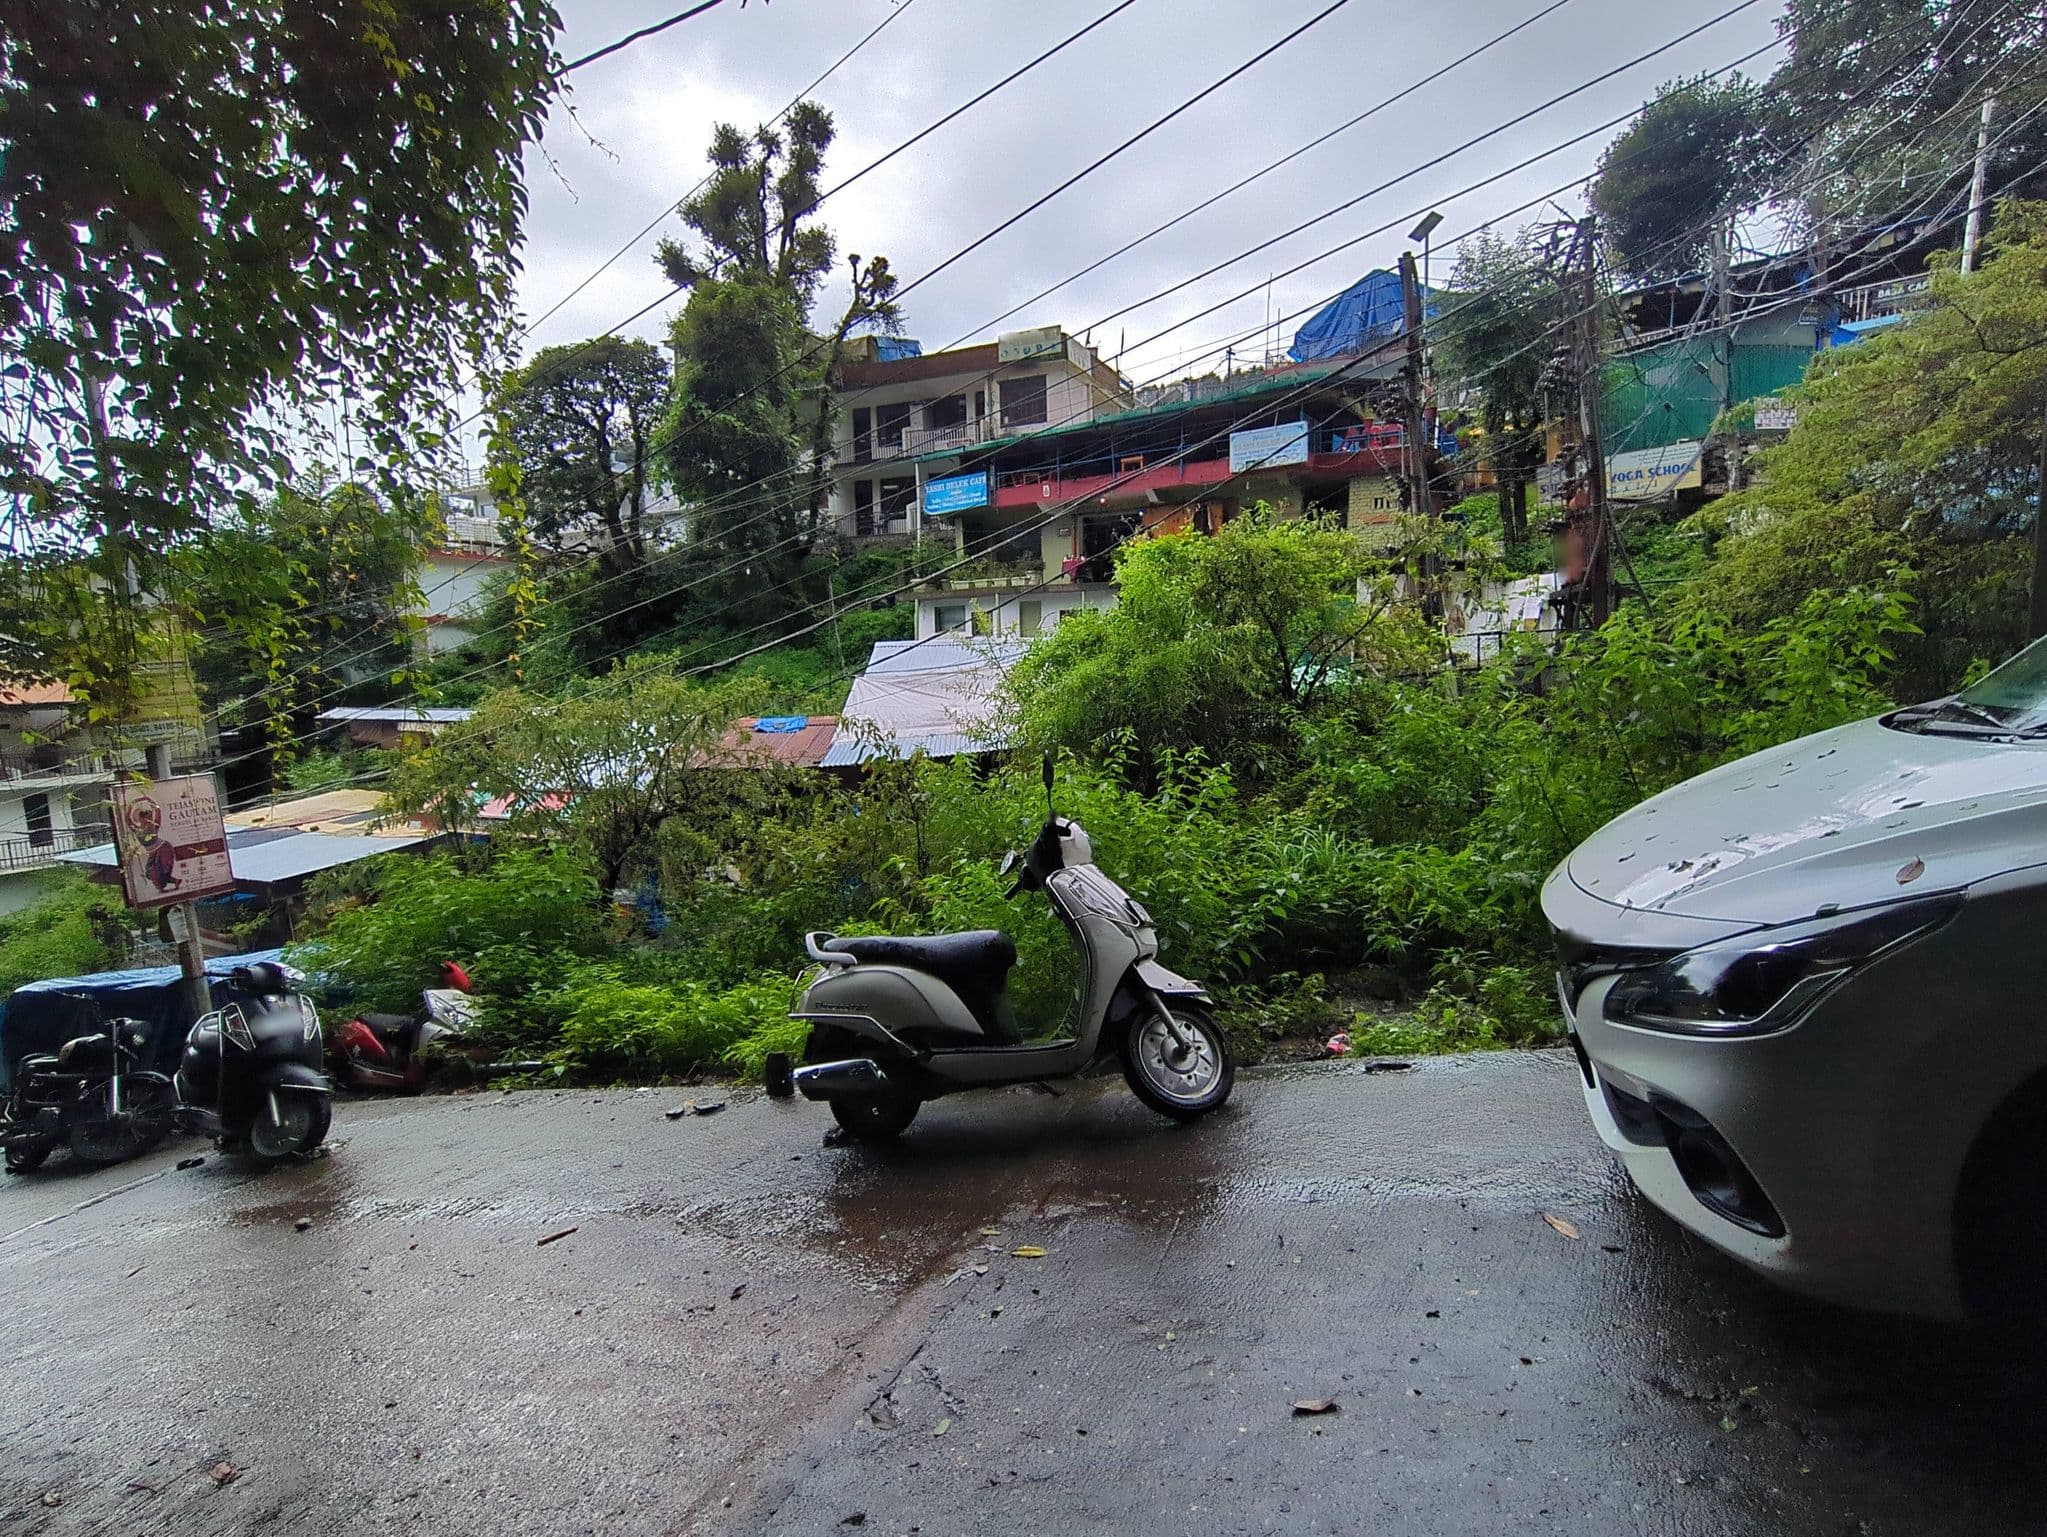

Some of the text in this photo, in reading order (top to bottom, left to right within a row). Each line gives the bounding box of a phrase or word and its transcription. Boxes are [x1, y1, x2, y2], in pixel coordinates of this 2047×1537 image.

[1907, 280, 1930, 292] CAF
[1611, 461, 1698, 482] YOGA SCHOOL
[925, 483, 945, 493] TASHI
[169, 805, 217, 820] GAUTAM
